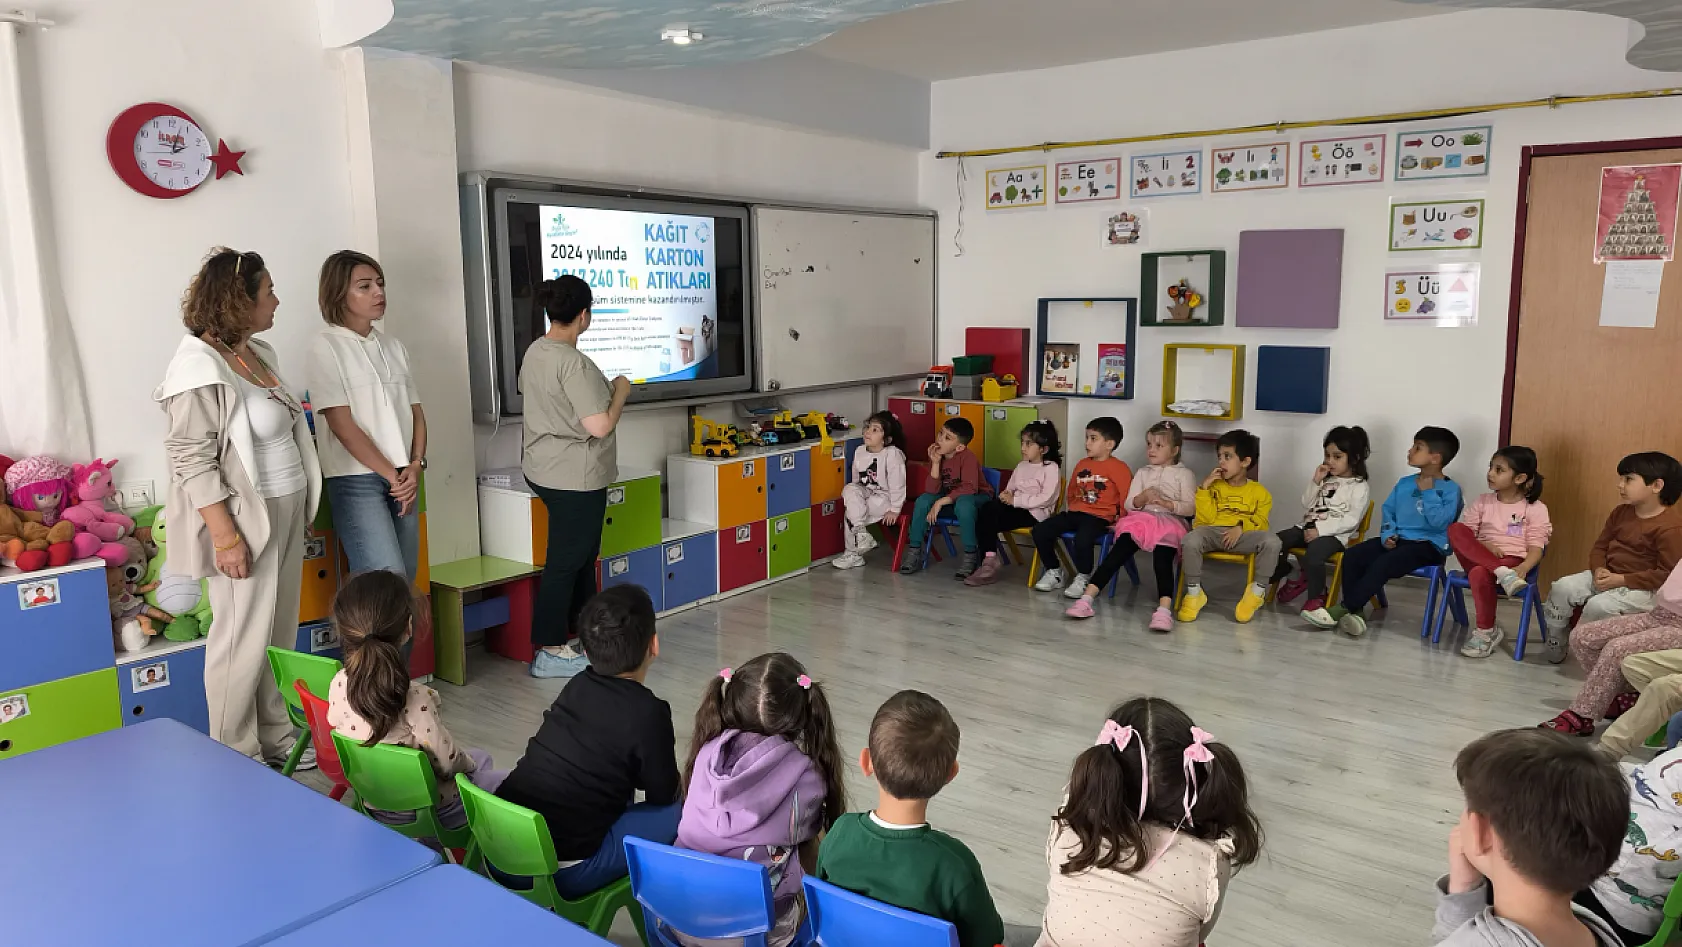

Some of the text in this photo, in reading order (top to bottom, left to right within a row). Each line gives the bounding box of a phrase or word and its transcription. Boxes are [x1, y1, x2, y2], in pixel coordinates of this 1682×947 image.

[153, 120, 159, 128] 11
[168, 119, 177, 128] 12
[140, 130, 149, 138] 10
[1431, 134, 1455, 148] Oo
[1332, 143, 1354, 159] Öö
[1006, 171, 1023, 184] Aa
[1078, 164, 1095, 180] Ee
[1423, 207, 1447, 222] Uu
[644, 220, 689, 243] KAĞIT
[550, 243, 628, 264] 2024 yılında
[645, 246, 704, 267] KARTON
[646, 271, 711, 290] ATIKLARI
[1417, 275, 1440, 295] Üü
